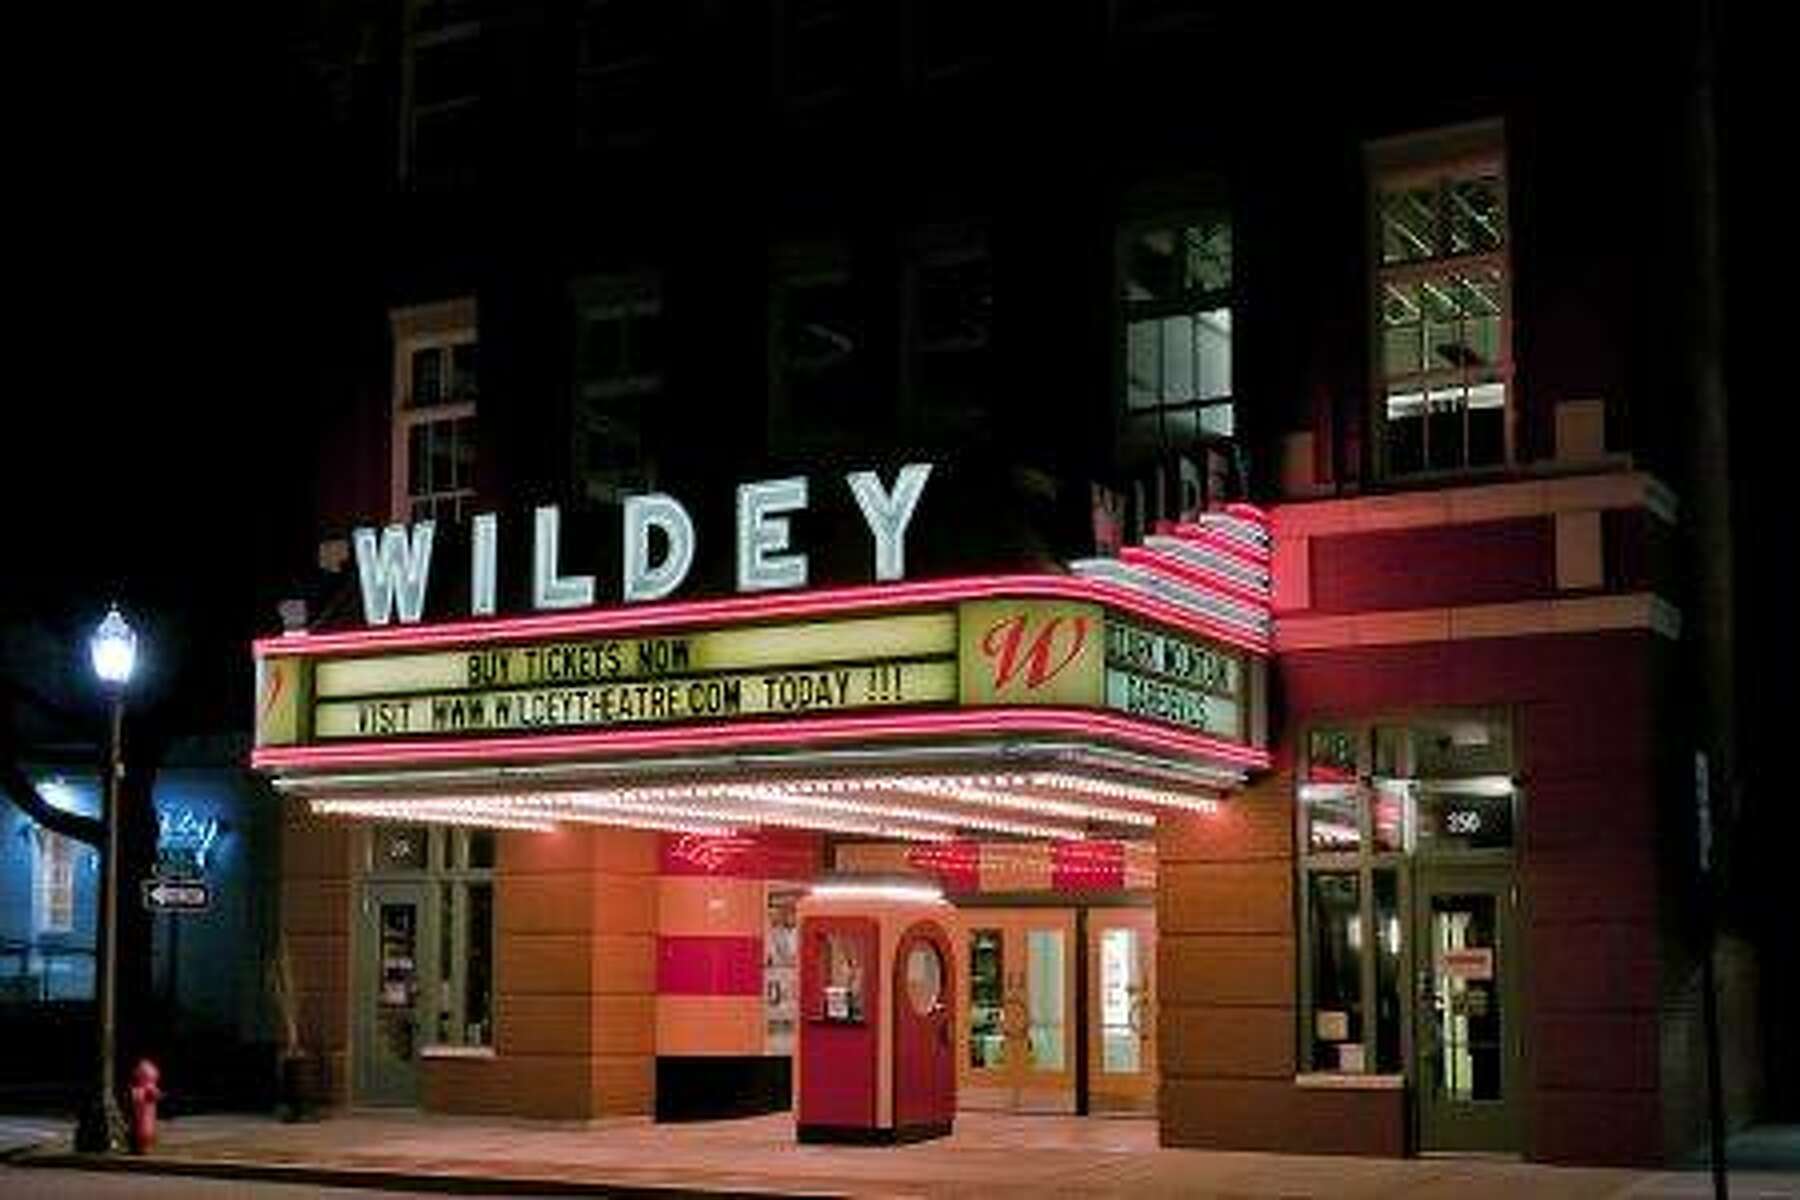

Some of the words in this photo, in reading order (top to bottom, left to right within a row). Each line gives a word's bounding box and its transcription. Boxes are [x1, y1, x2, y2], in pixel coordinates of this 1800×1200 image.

[352, 463, 934, 626] WILDEY
[466, 652, 510, 684] BUY
[525, 643, 621, 681] TICKETS
[979, 612, 1091, 690] W
[356, 702, 411, 734] VISIT
[764, 671, 850, 709] TODAY
[867, 664, 904, 701] !!!
